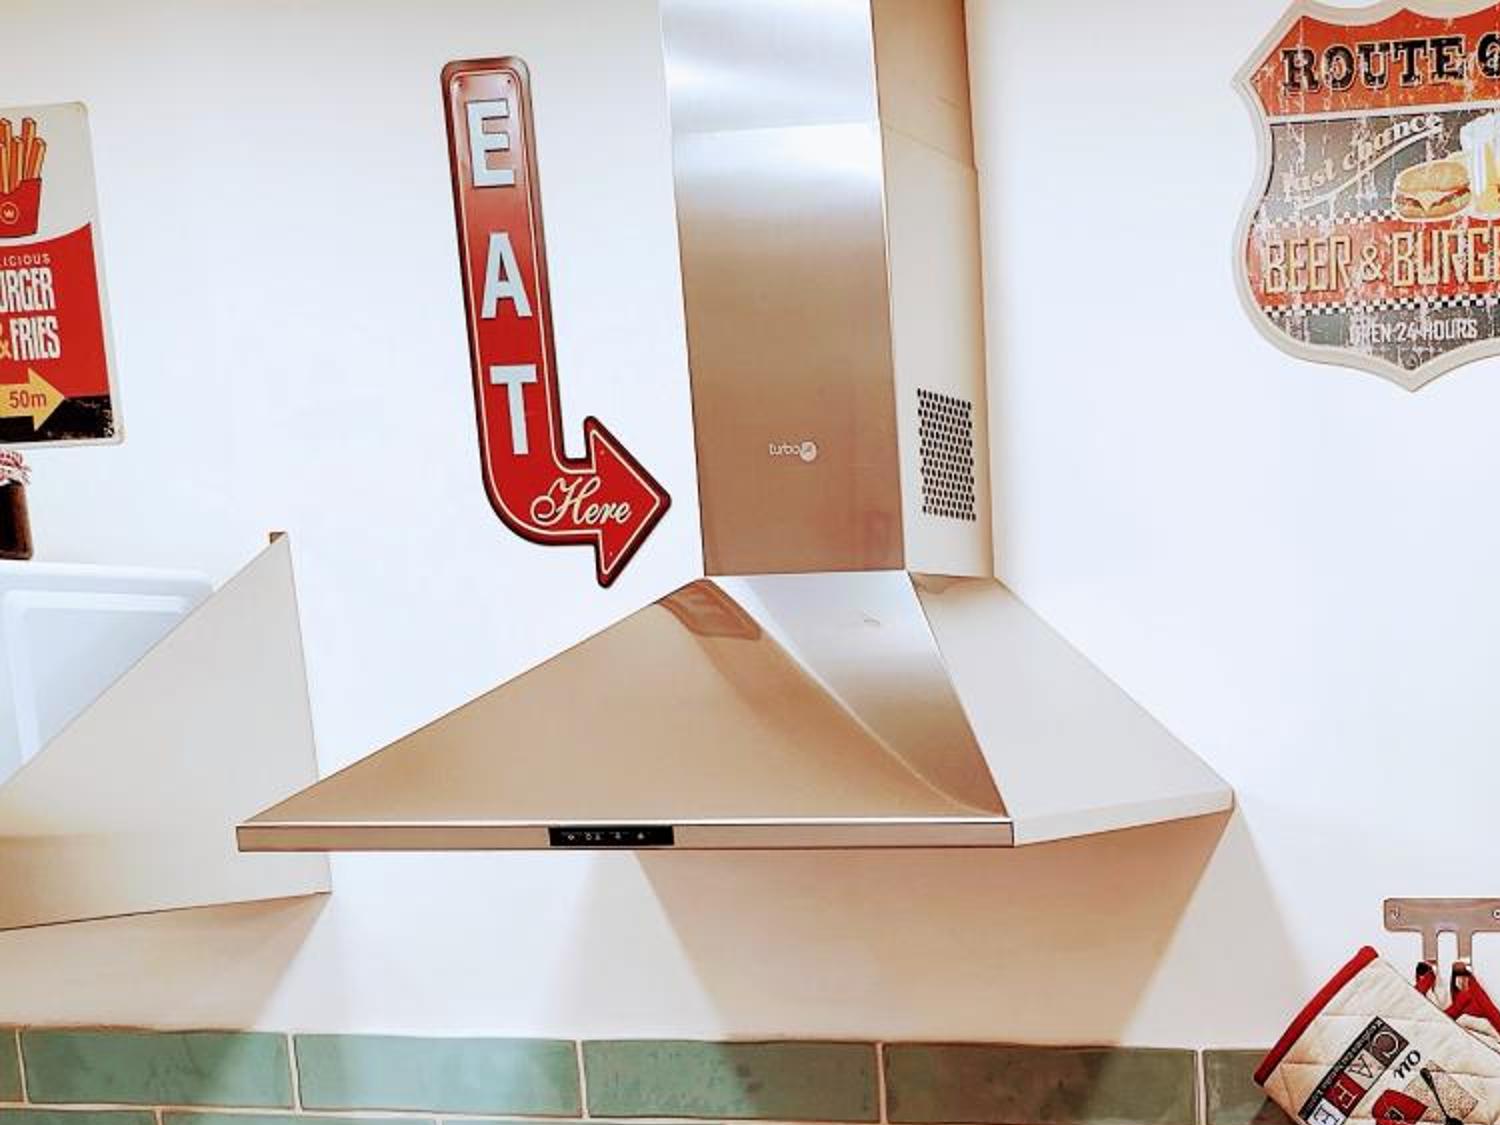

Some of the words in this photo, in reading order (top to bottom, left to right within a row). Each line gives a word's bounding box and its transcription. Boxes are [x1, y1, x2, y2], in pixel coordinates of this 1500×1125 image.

[1279, 34, 1467, 93] ROUTE
[0, 253, 51, 267] ICIOUS
[466, 97, 538, 456] EAT
[1264, 234, 1353, 295] BEER
[1361, 244, 1384, 284] &
[9, 315, 61, 361] FRIES
[1396, 321, 1418, 342] 24
[1423, 318, 1478, 341] HOURS
[9, 389, 47, 409] 50m
[530, 469, 632, 528] Here
